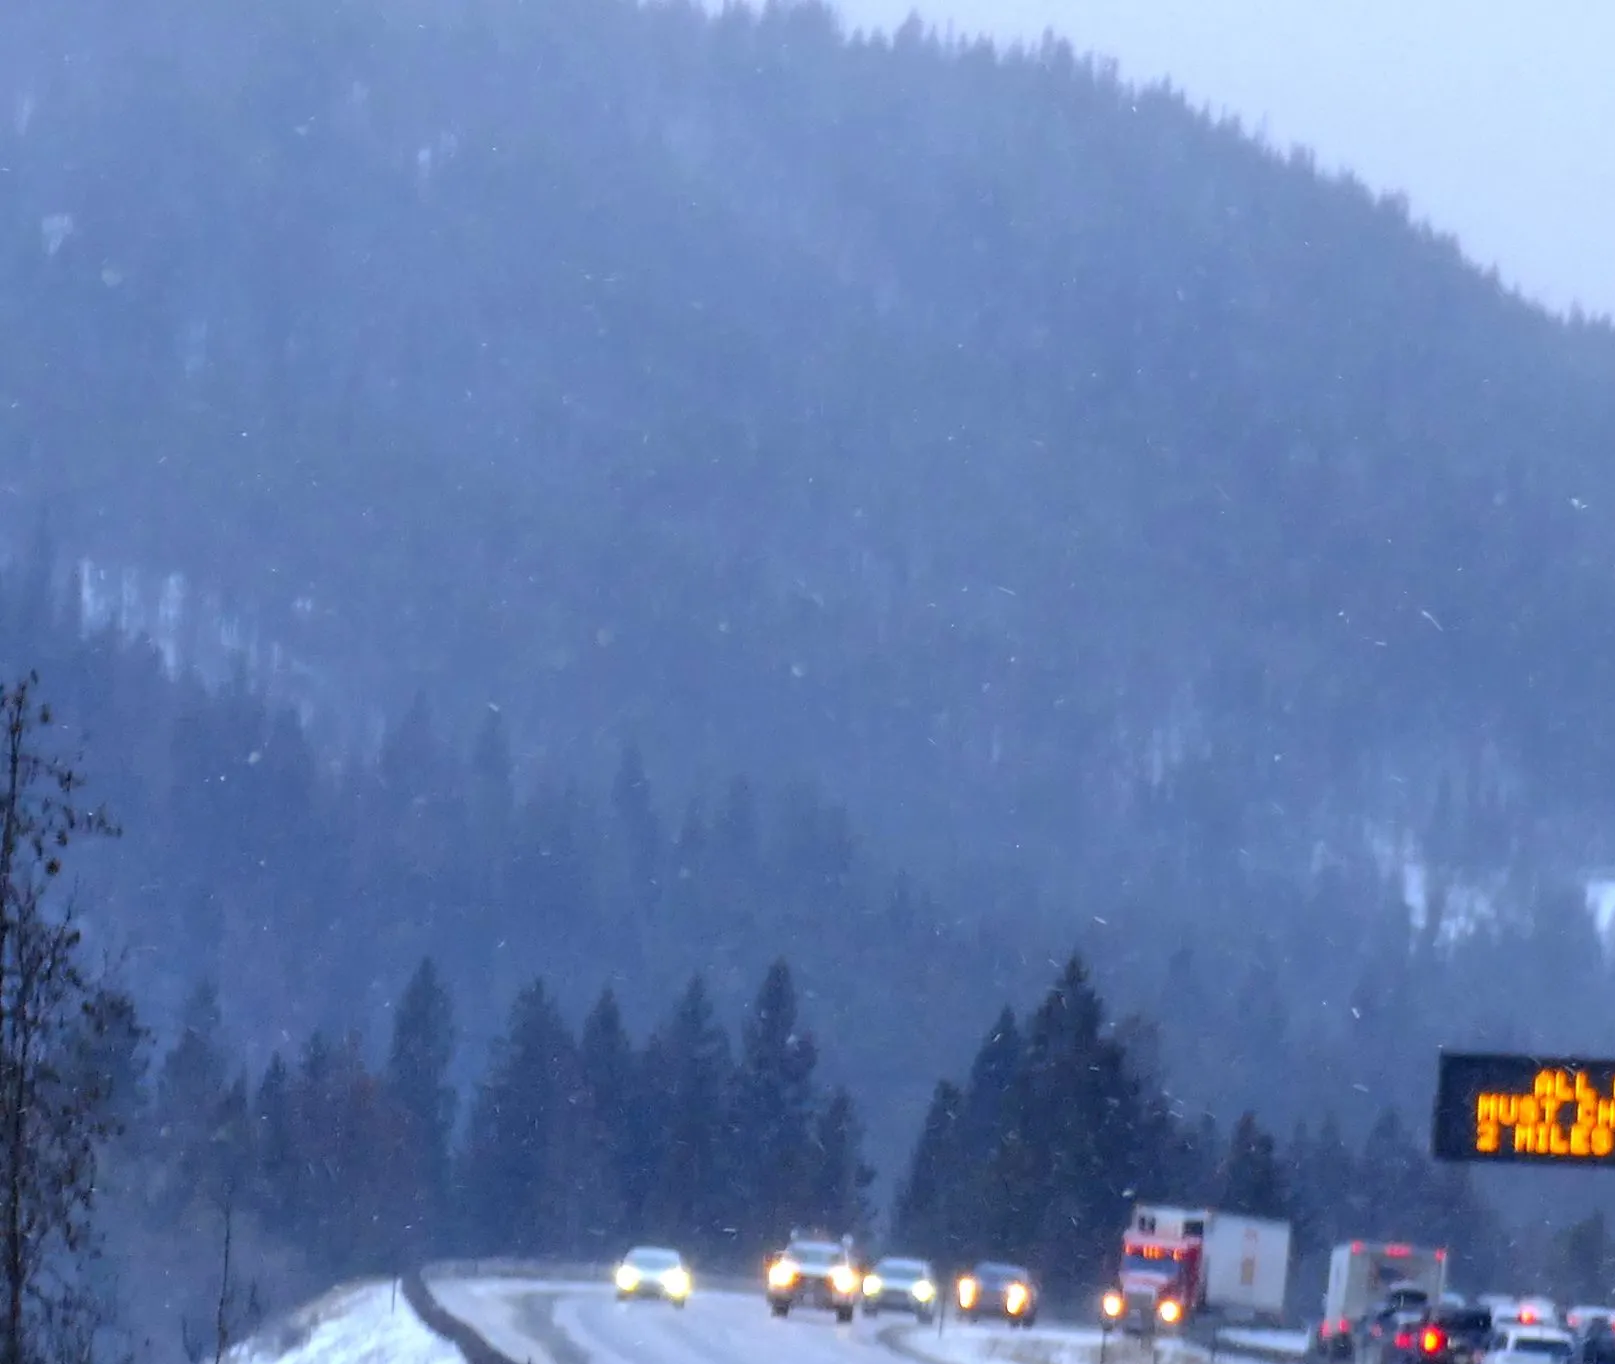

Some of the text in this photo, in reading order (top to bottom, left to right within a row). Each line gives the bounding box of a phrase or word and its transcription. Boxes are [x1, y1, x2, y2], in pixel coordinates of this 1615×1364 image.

[1534, 1069, 1598, 1102] ALL
[1476, 1092, 1559, 1126] MUST
[1514, 1123, 1615, 1156] MILES
